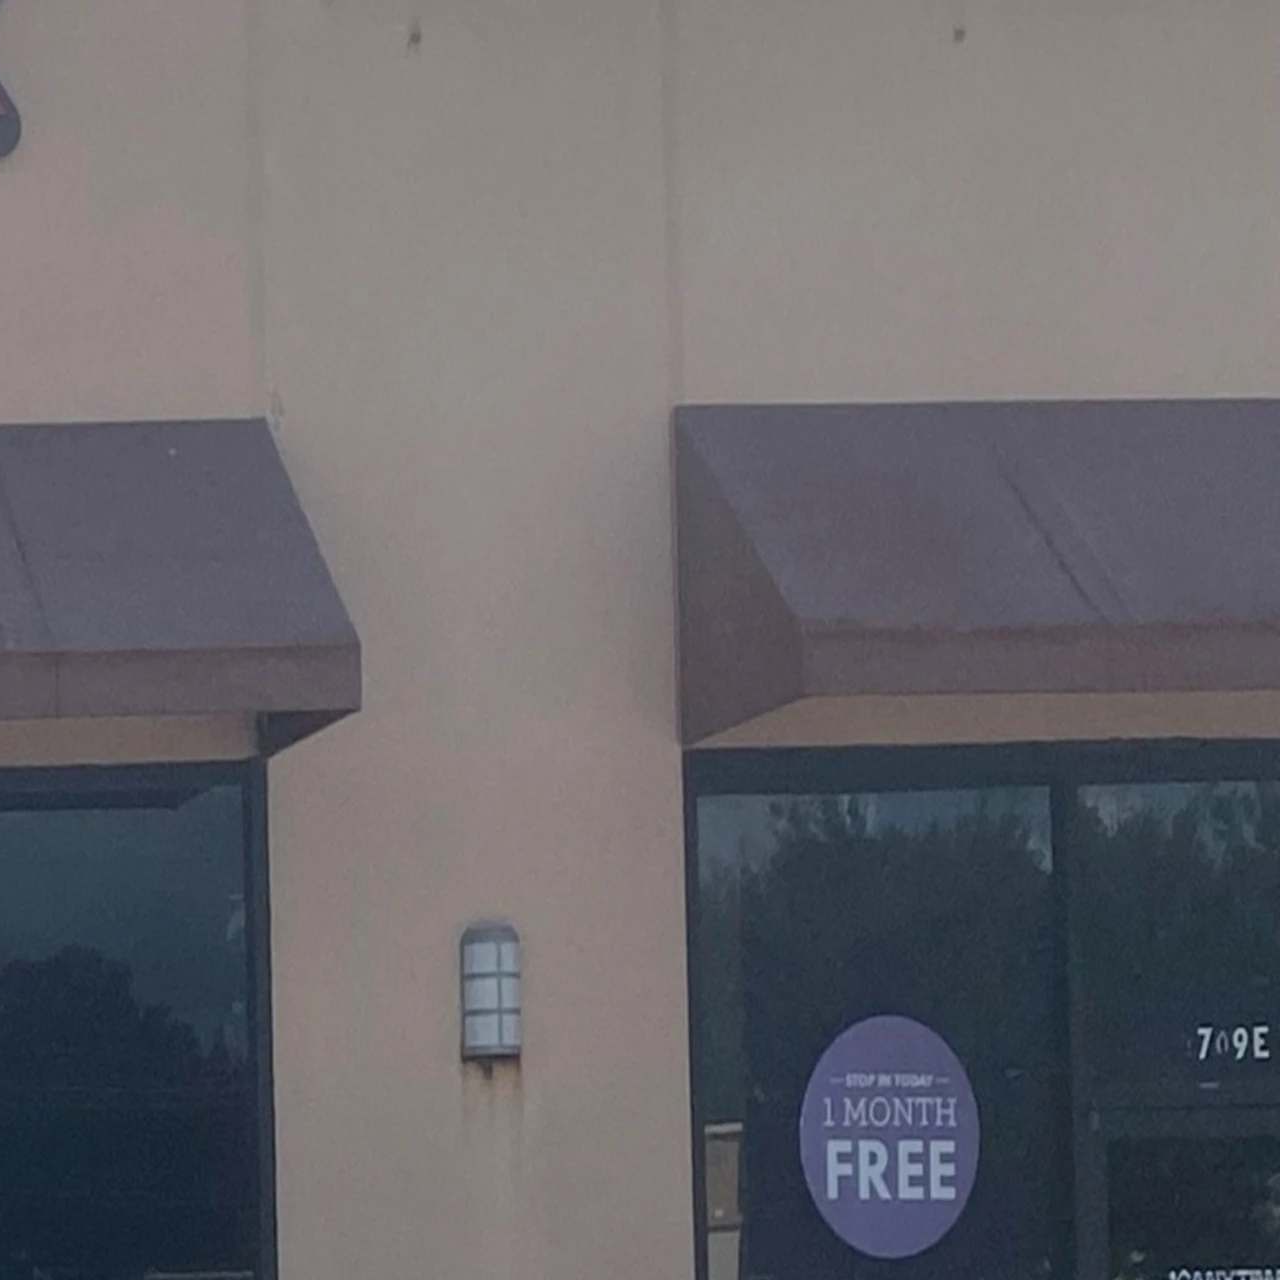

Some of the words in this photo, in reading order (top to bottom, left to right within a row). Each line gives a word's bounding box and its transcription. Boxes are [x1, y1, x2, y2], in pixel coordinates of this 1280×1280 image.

[823, 1097, 835, 1127] 1
[843, 1096, 957, 1127] MONTH
[827, 1139, 957, 1200] FREE
